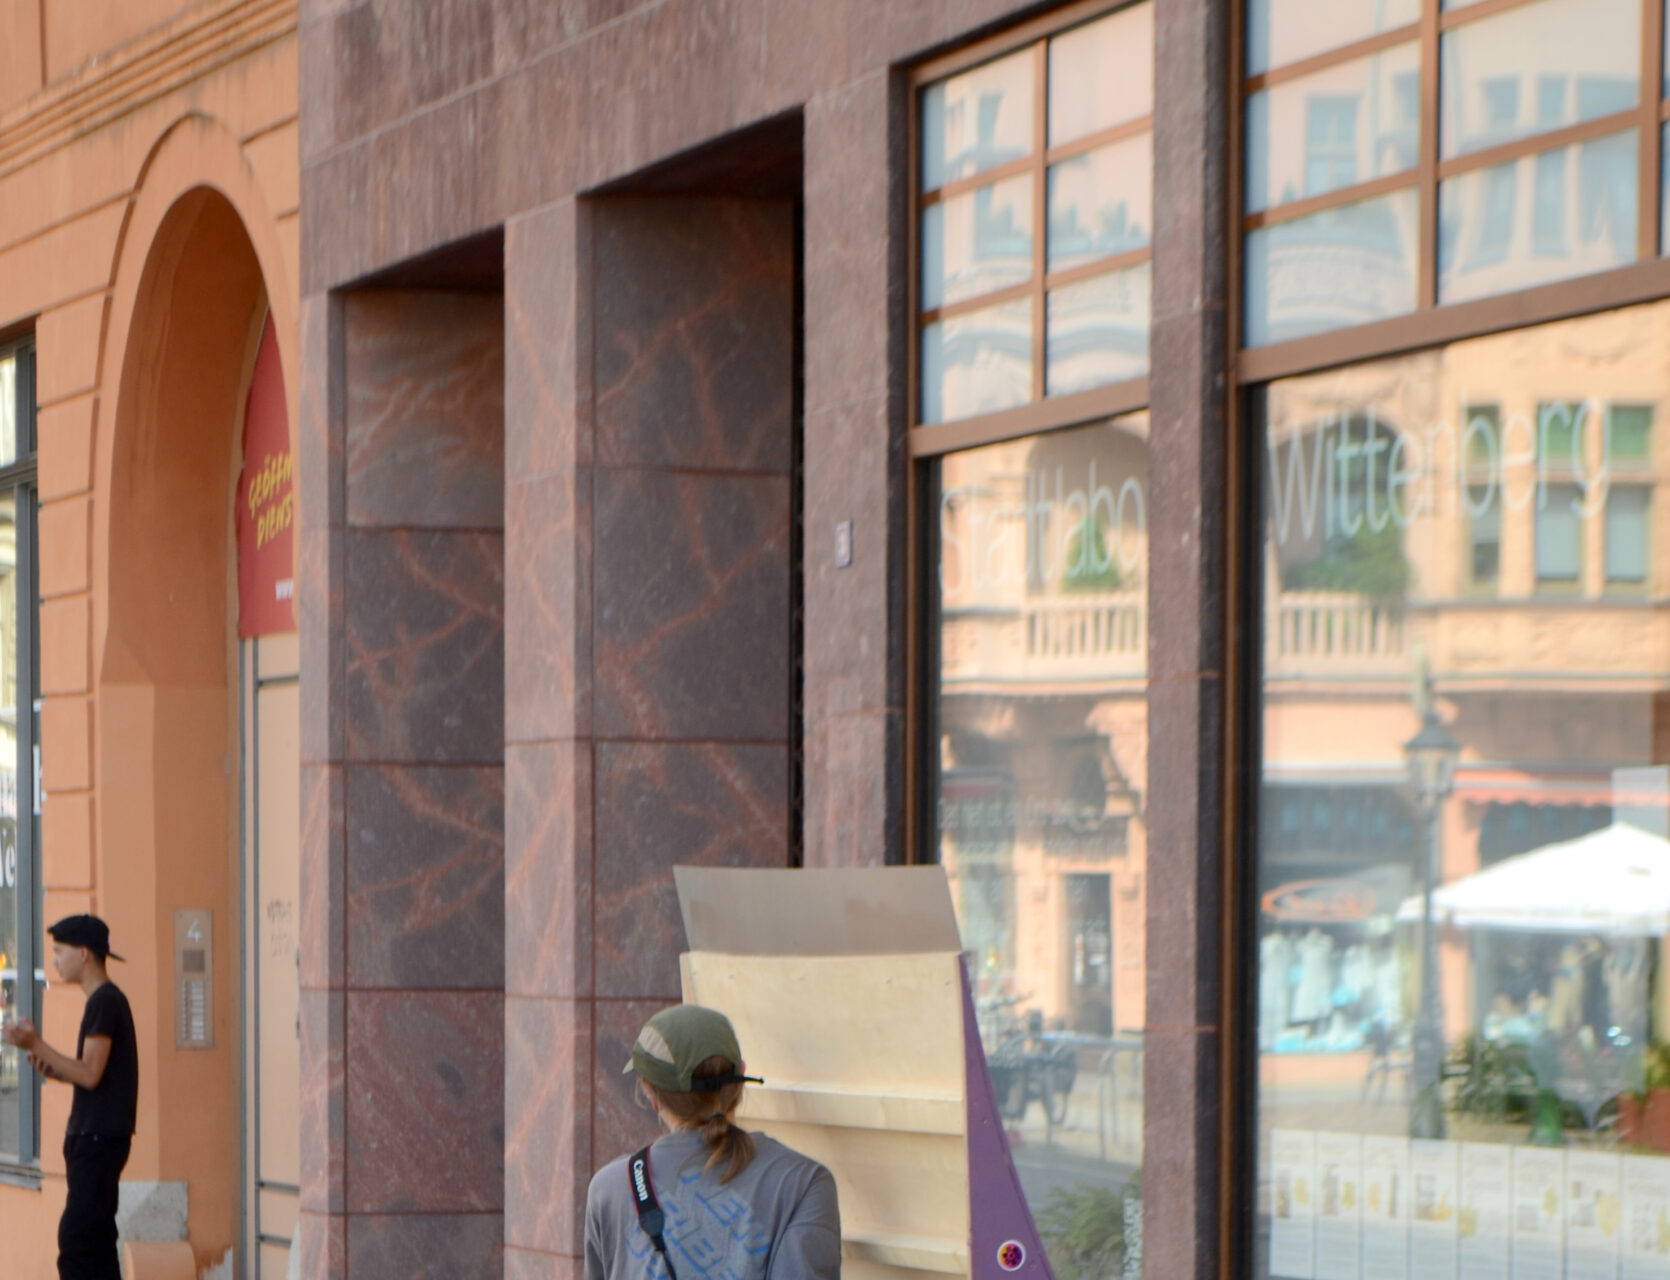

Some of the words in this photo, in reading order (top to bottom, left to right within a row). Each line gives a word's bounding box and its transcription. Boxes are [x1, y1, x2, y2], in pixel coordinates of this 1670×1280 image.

[1268, 389, 1612, 546] Wittenberg
[187, 919, 202, 944] 4
[633, 1159, 648, 1201] Canon
